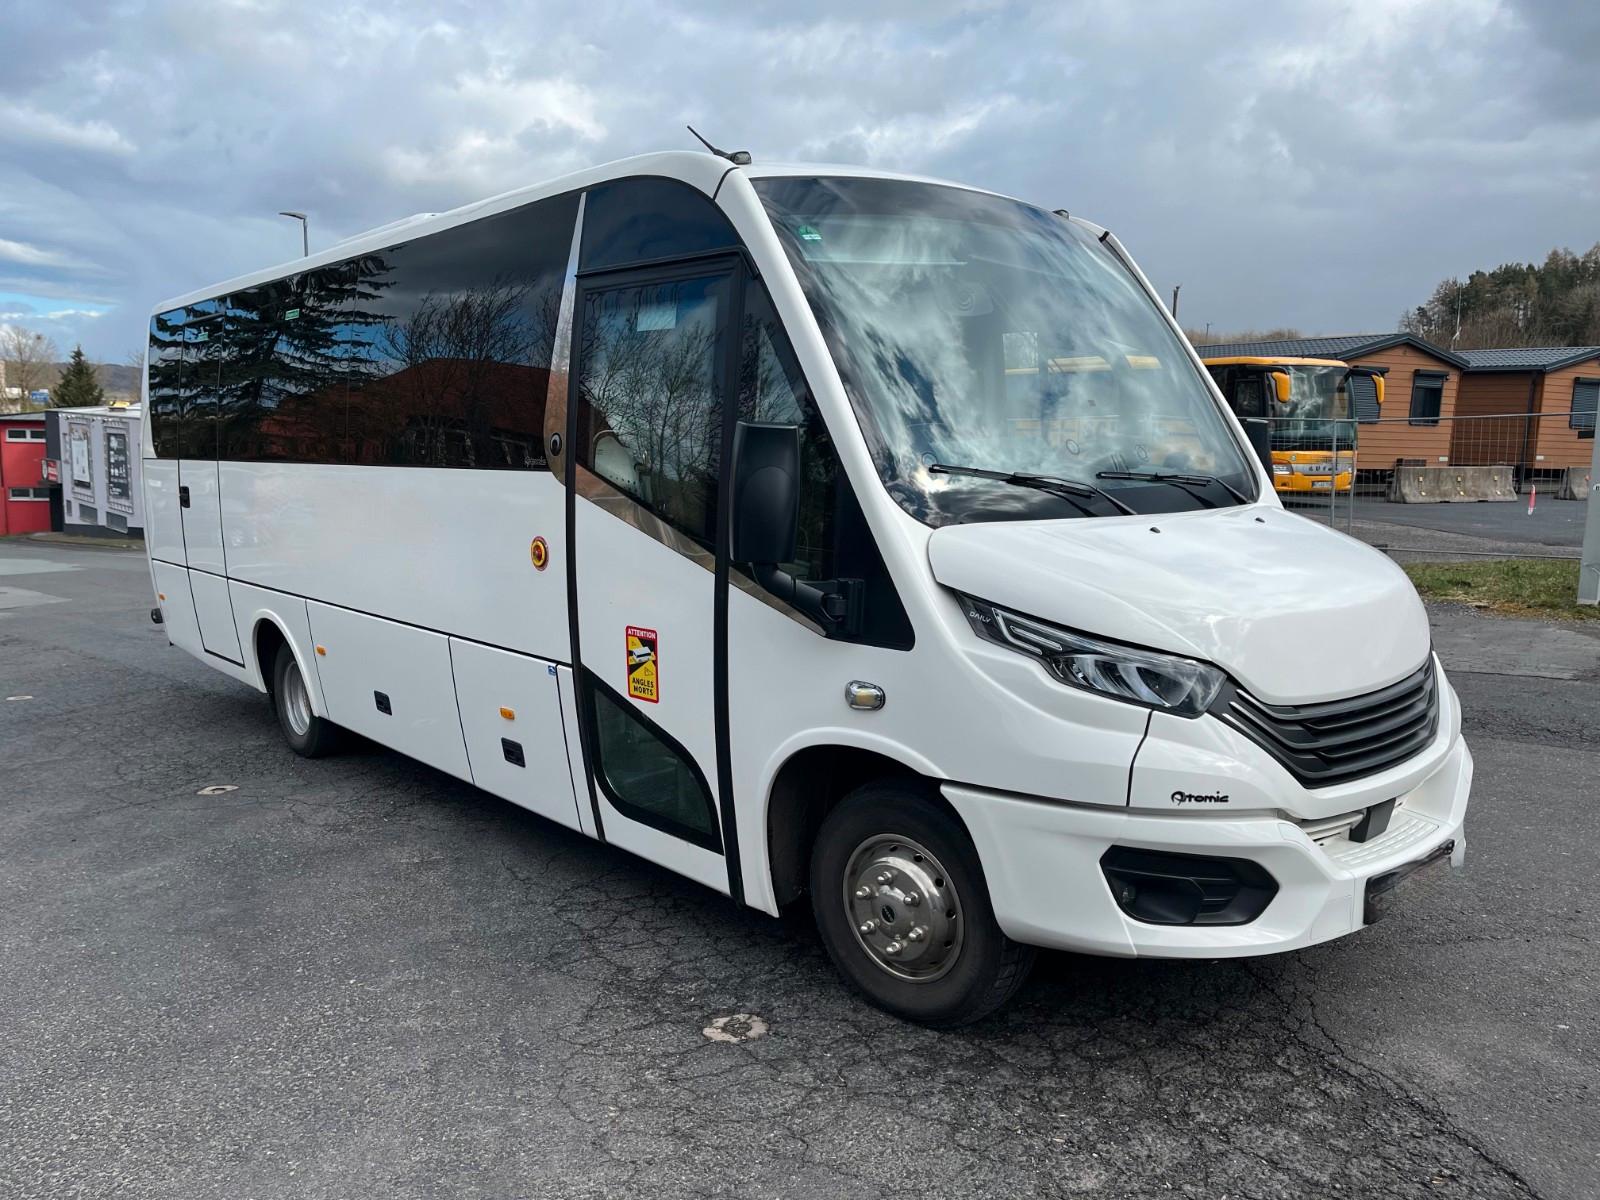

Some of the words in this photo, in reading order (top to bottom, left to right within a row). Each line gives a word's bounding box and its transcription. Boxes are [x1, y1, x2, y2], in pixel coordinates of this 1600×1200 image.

[969, 611, 991, 623] DAILY
[628, 628, 656, 639] ATTENTION
[632, 677, 654, 688] ANGLES
[633, 685, 654, 696] MORTS
